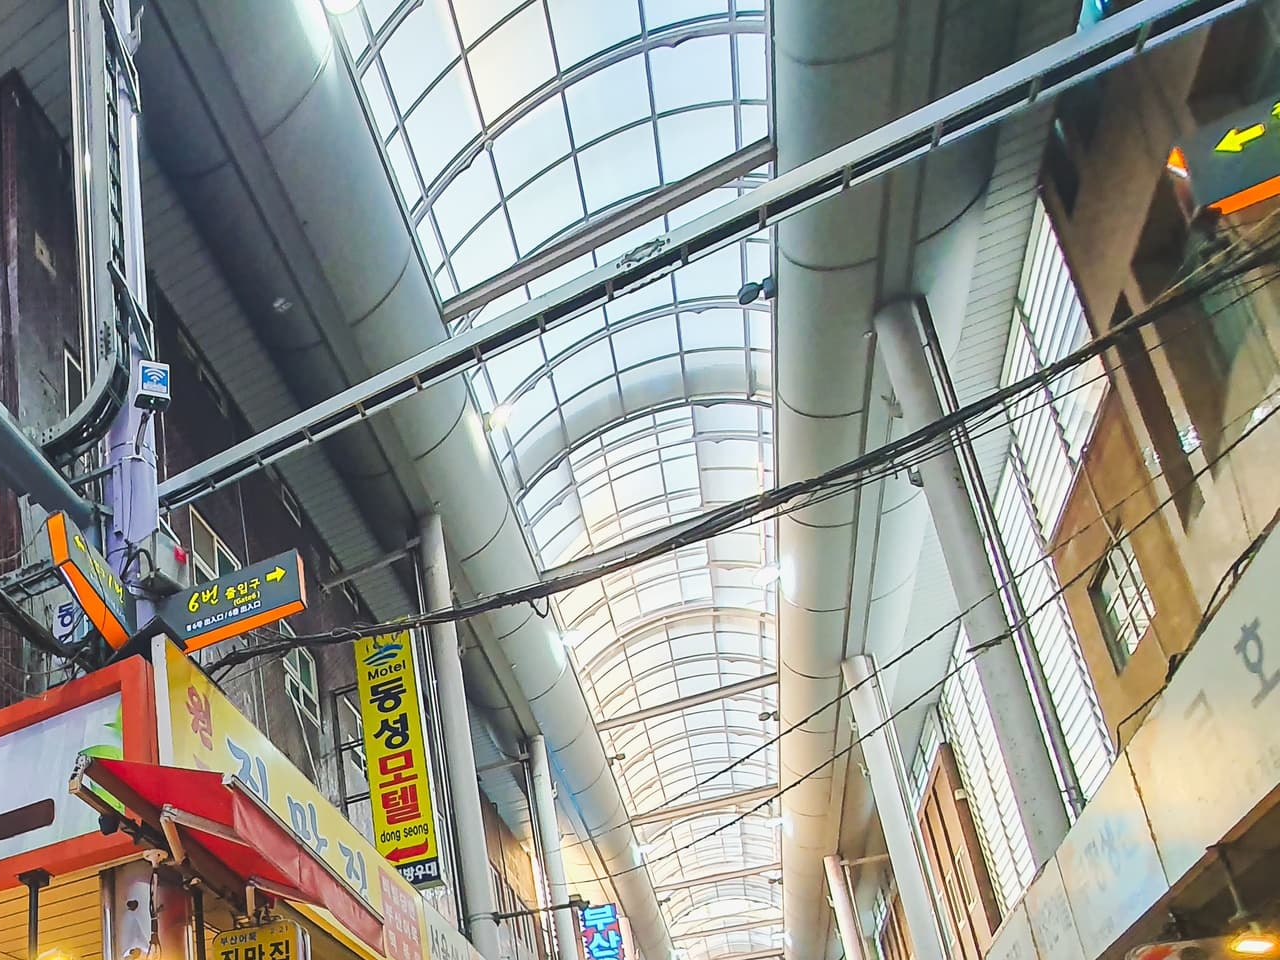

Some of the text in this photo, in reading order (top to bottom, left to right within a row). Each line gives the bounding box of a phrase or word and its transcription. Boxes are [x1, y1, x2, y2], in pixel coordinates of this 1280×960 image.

[188, 578, 261, 613] 6번 출입구
[367, 659, 407, 681] Motel
[369, 676, 422, 825] 동성모텔
[380, 822, 429, 844] dong seong
